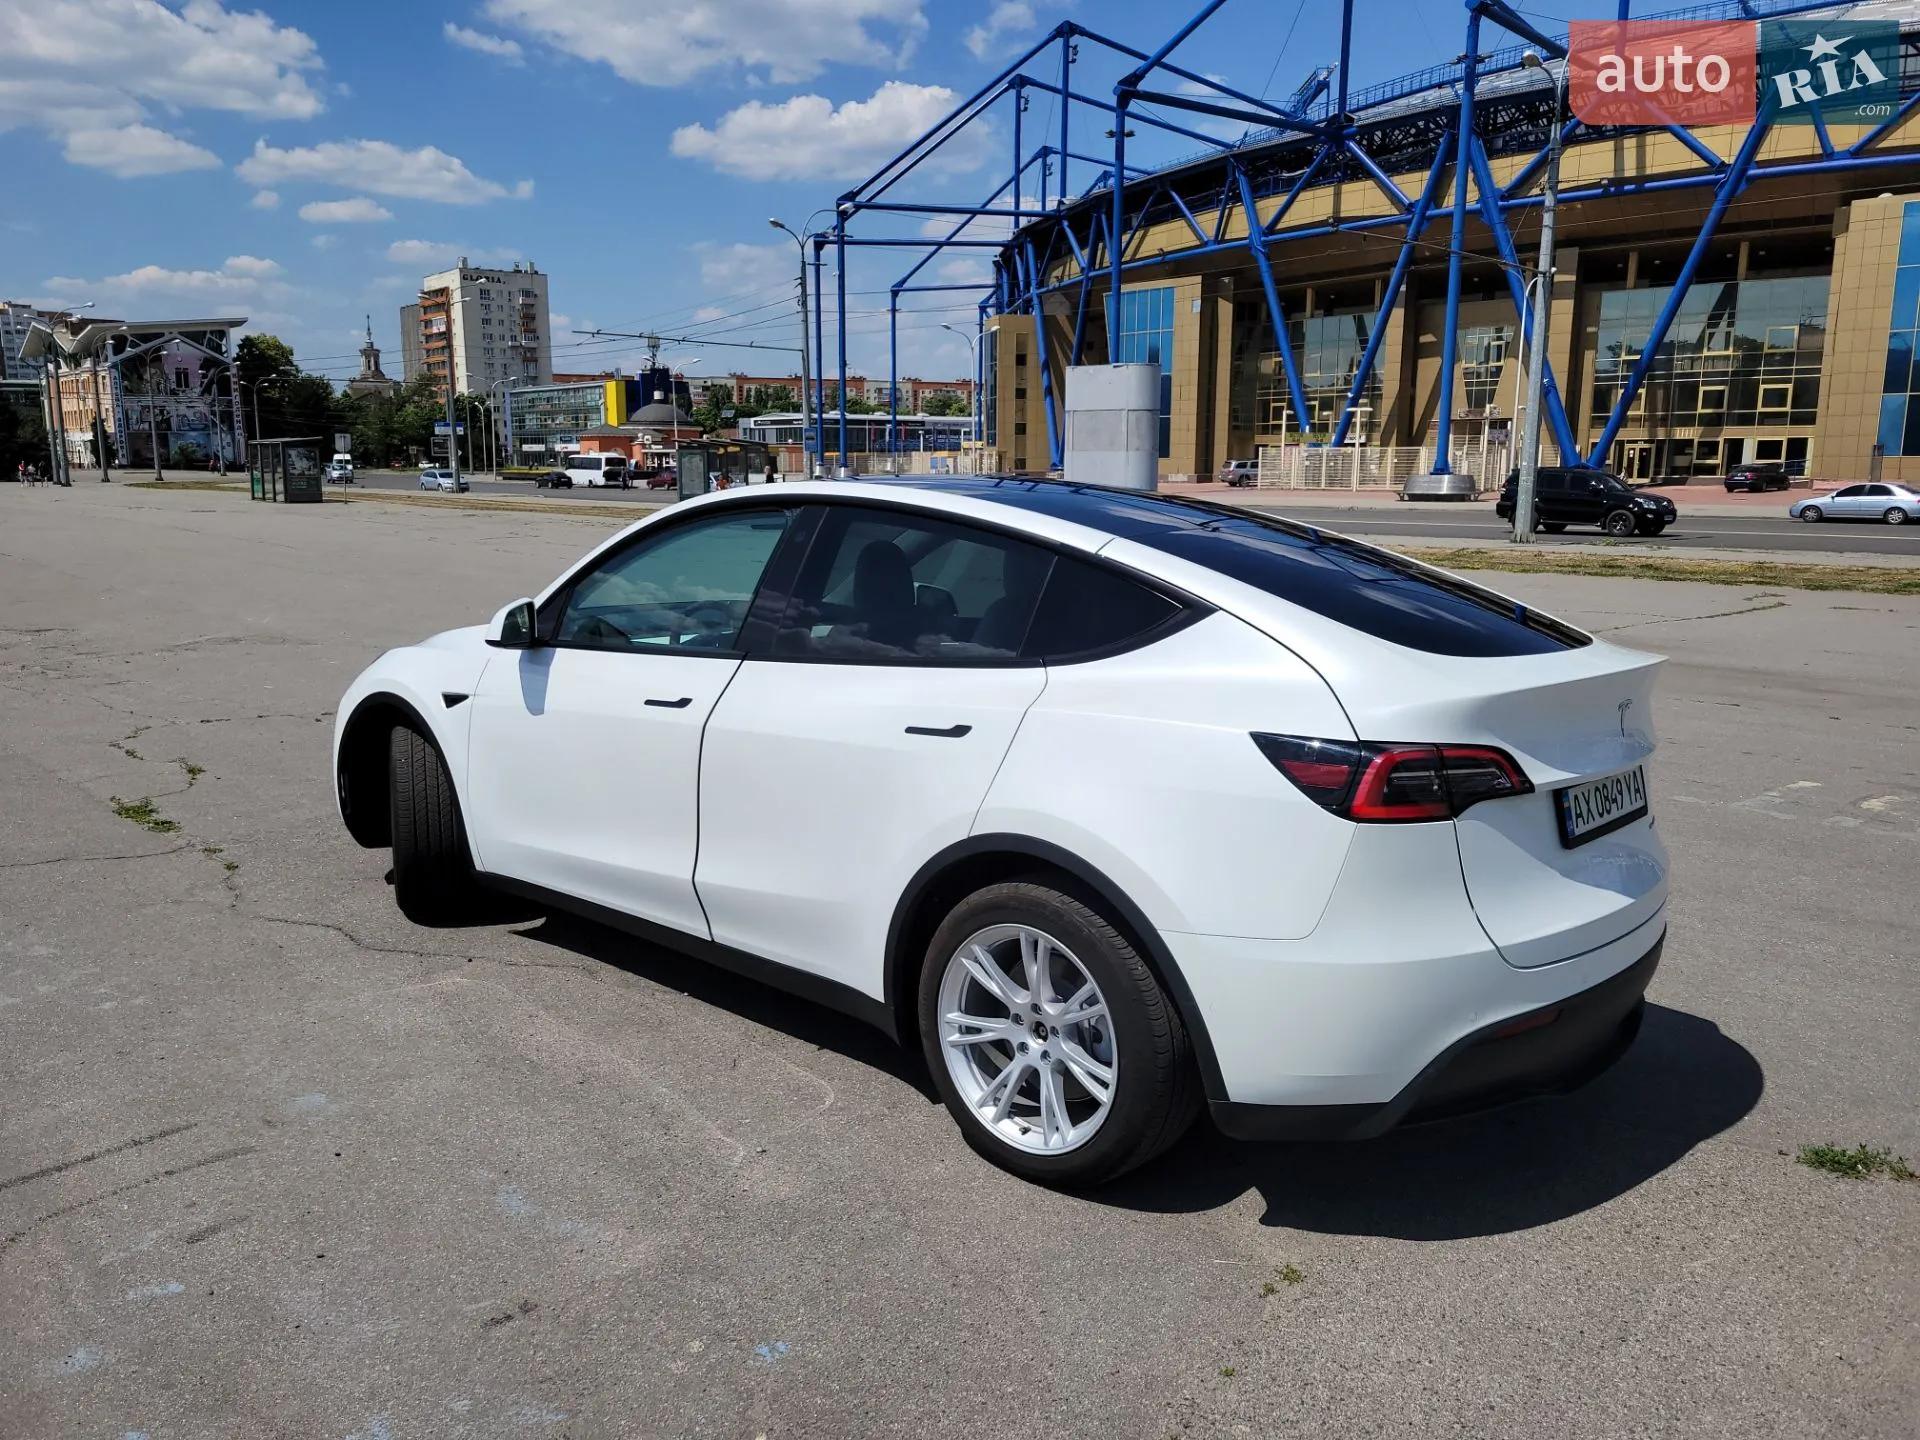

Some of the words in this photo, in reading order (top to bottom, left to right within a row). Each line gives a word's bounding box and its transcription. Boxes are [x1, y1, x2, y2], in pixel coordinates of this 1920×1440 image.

[1574, 789, 1596, 828] AX
[1594, 778, 1624, 819] 0849
[1624, 770, 1643, 805] YA
